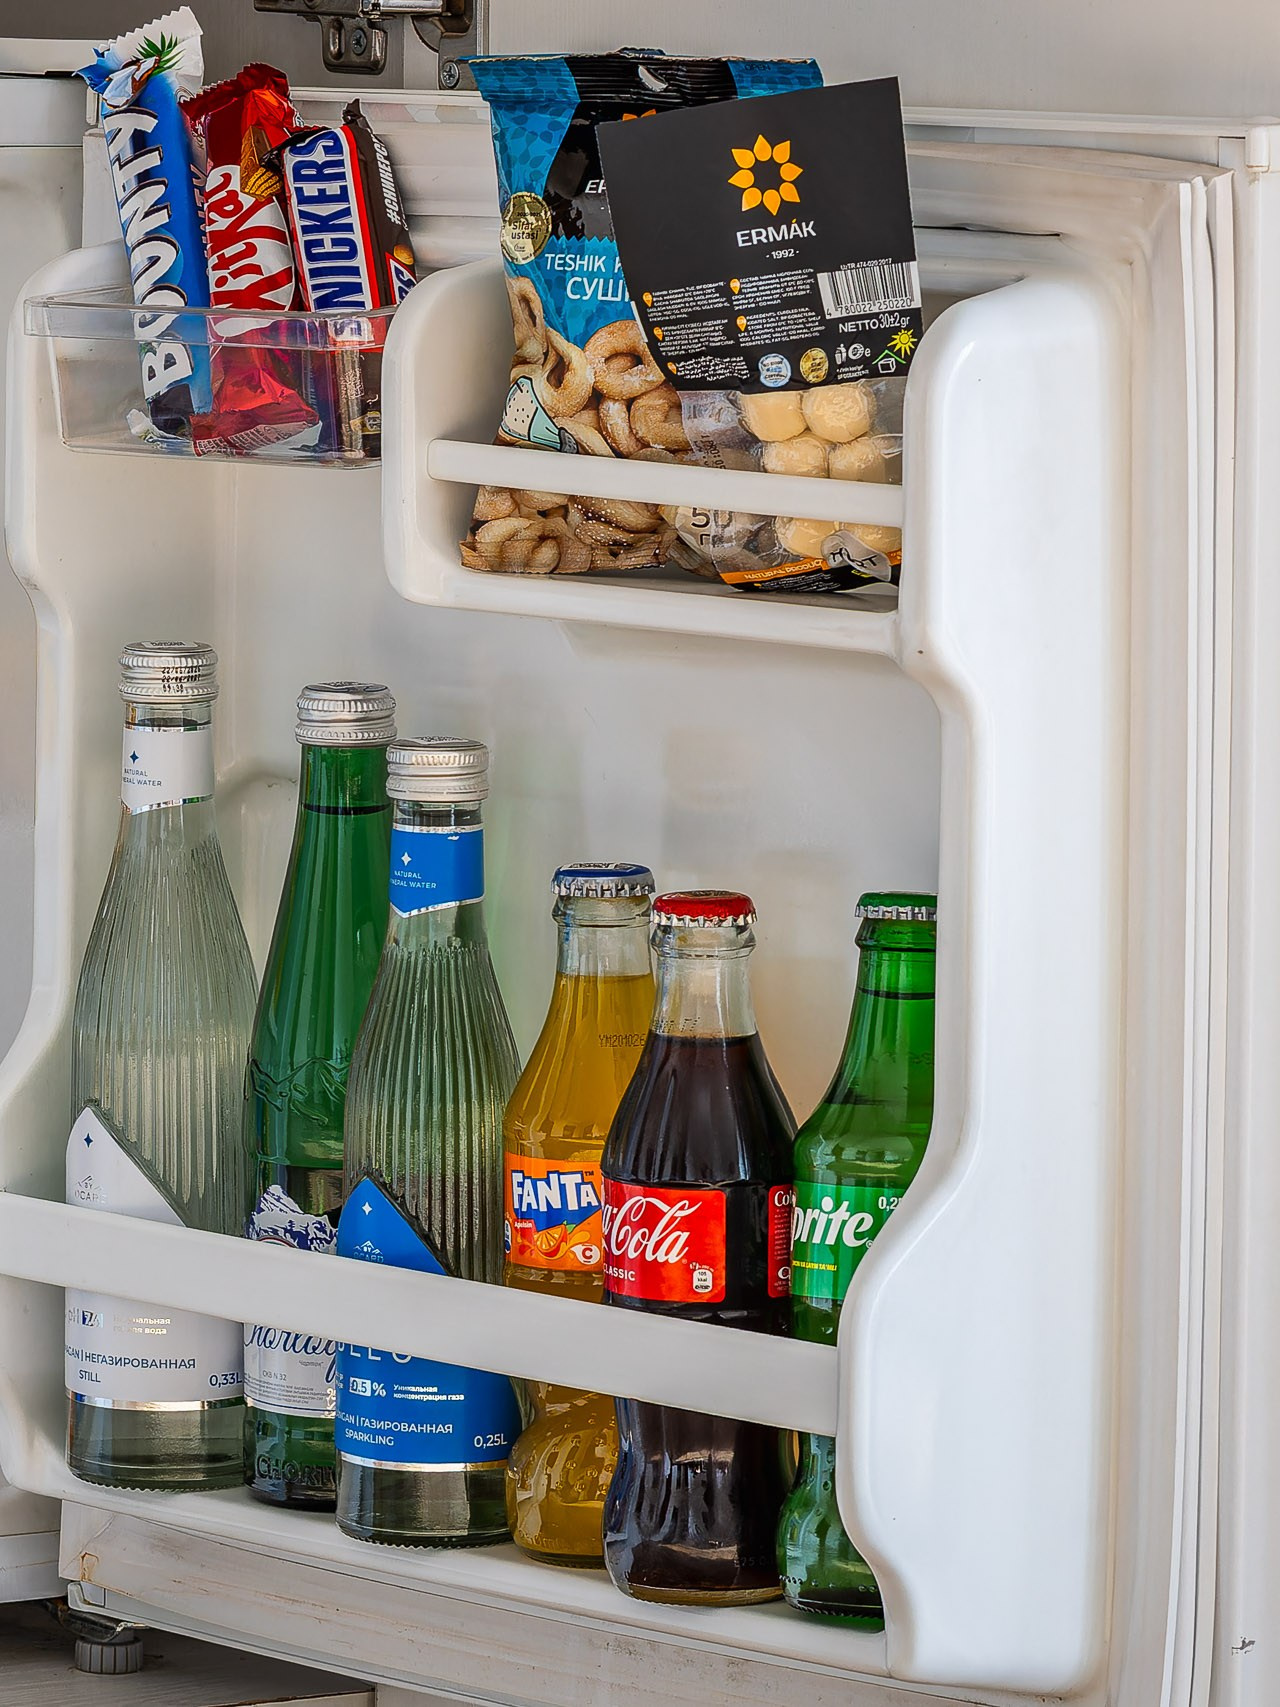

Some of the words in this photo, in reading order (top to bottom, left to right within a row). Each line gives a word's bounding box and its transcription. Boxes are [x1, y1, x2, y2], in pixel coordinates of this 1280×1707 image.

[511, 230, 539, 240] ustasi
[736, 218, 817, 248] ERMÁK
[545, 254, 607, 272] TESHIK
[838, 300, 873, 315] 780022
[877, 297, 912, 310] 250220
[838, 318, 879, 333] NETTO
[784, 558, 823, 573] PRODUC
[137, 779, 162, 787] WATER
[394, 870, 422, 879] NATURAL
[409, 881, 437, 889] WATER
[512, 1172, 599, 1212] FANTA
[790, 1196, 874, 1251] prite
[144, 1327, 167, 1335] вода
[84, 1353, 196, 1369] НЕГАЗИРОВАННАЯ
[78, 1369, 101, 1383] STILL
[279, 1373, 287, 1381] 32
[393, 1384, 438, 1393] Уникальная
[393, 1392, 447, 1401] концентрация
[360, 1417, 453, 1434] ГАЗИРОВАННАЯ
[345, 1428, 395, 1446] SPARKLING
[474, 1433, 508, 1450] 0,25L
